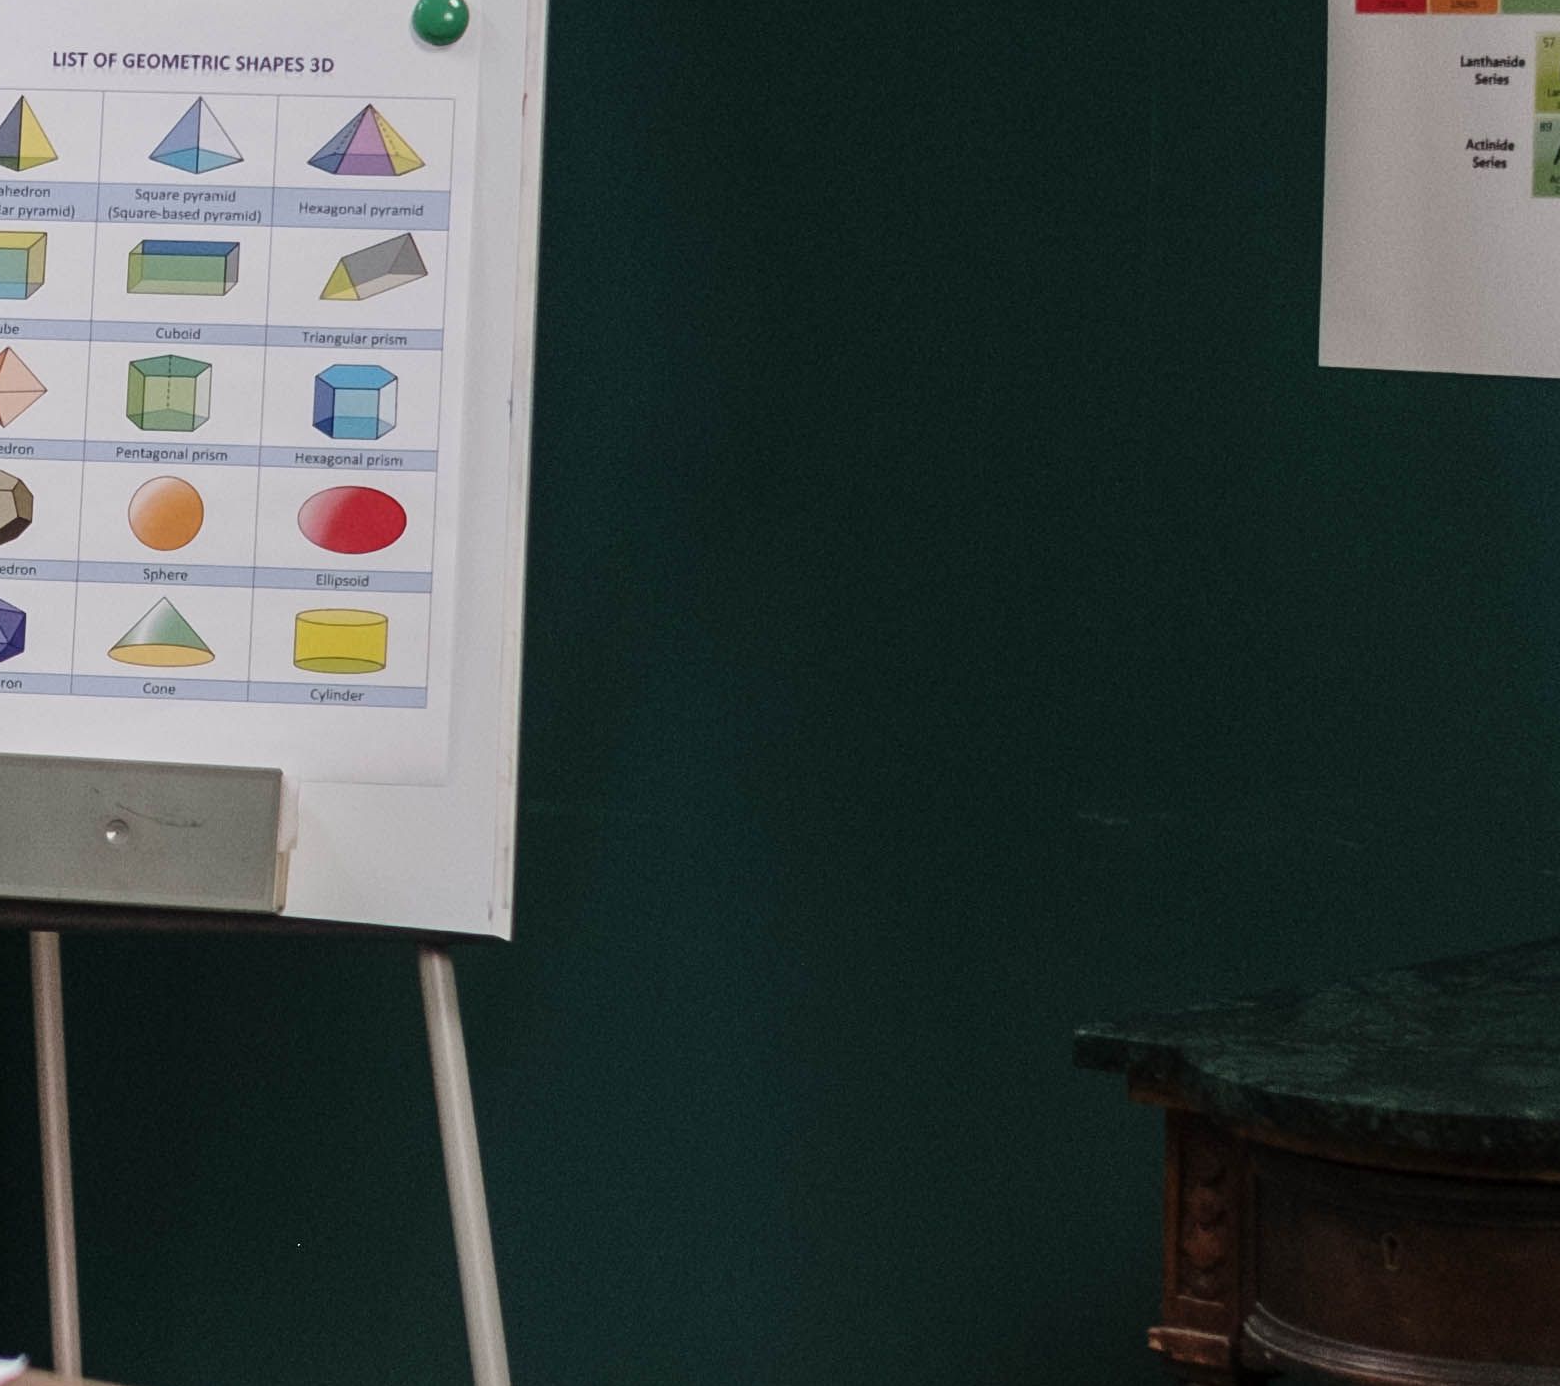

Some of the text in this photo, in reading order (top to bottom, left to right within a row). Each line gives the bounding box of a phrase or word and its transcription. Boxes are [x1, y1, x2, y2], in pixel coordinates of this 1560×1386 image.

[53, 52, 334, 73] LIST OF GEOMETRIC SHAPES 3D
[1460, 55, 1526, 70] Lanthanide
[1474, 73, 1510, 88] Series
[1466, 139, 1515, 155] Actinide
[1472, 156, 1508, 172] Series
[135, 189, 236, 204] Square pyramid
[17, 204, 75, 219] pyramid)
[108, 207, 261, 224] (Square-based pyramid)
[299, 202, 424, 219] Hexagonal pyramid
[156, 327, 201, 340] Cuboid
[302, 332, 407, 348] Triangular prism
[116, 447, 228, 463] Pentagonal prism
[295, 453, 402, 468] Hexagonal prism
[143, 568, 188, 584] Sphere
[316, 574, 370, 589] Ellipsoid
[143, 683, 175, 696] Cone
[310, 689, 364, 703] Cylinder
